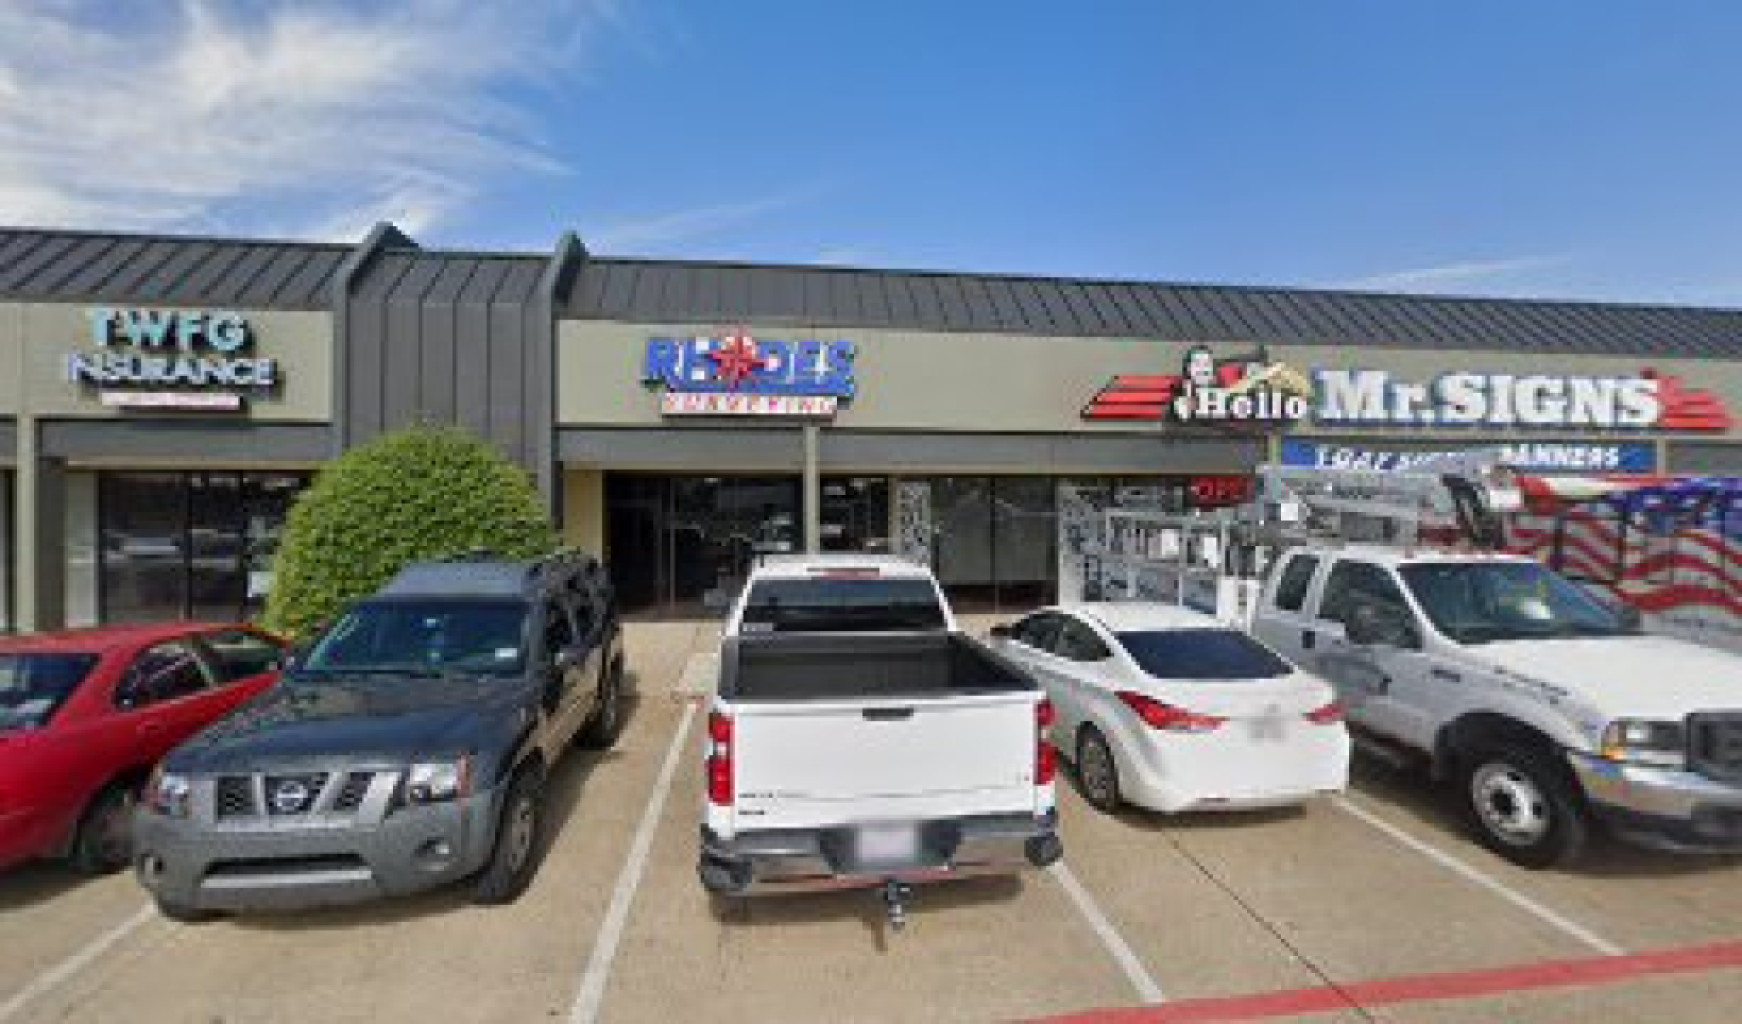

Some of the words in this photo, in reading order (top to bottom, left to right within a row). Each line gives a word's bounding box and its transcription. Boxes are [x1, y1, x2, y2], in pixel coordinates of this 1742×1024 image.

[86, 307, 250, 351] TWFG
[66, 354, 276, 386] INSURANCE
[1196, 386, 1307, 421] Hello
[1440, 373, 1661, 425] SIGNS
